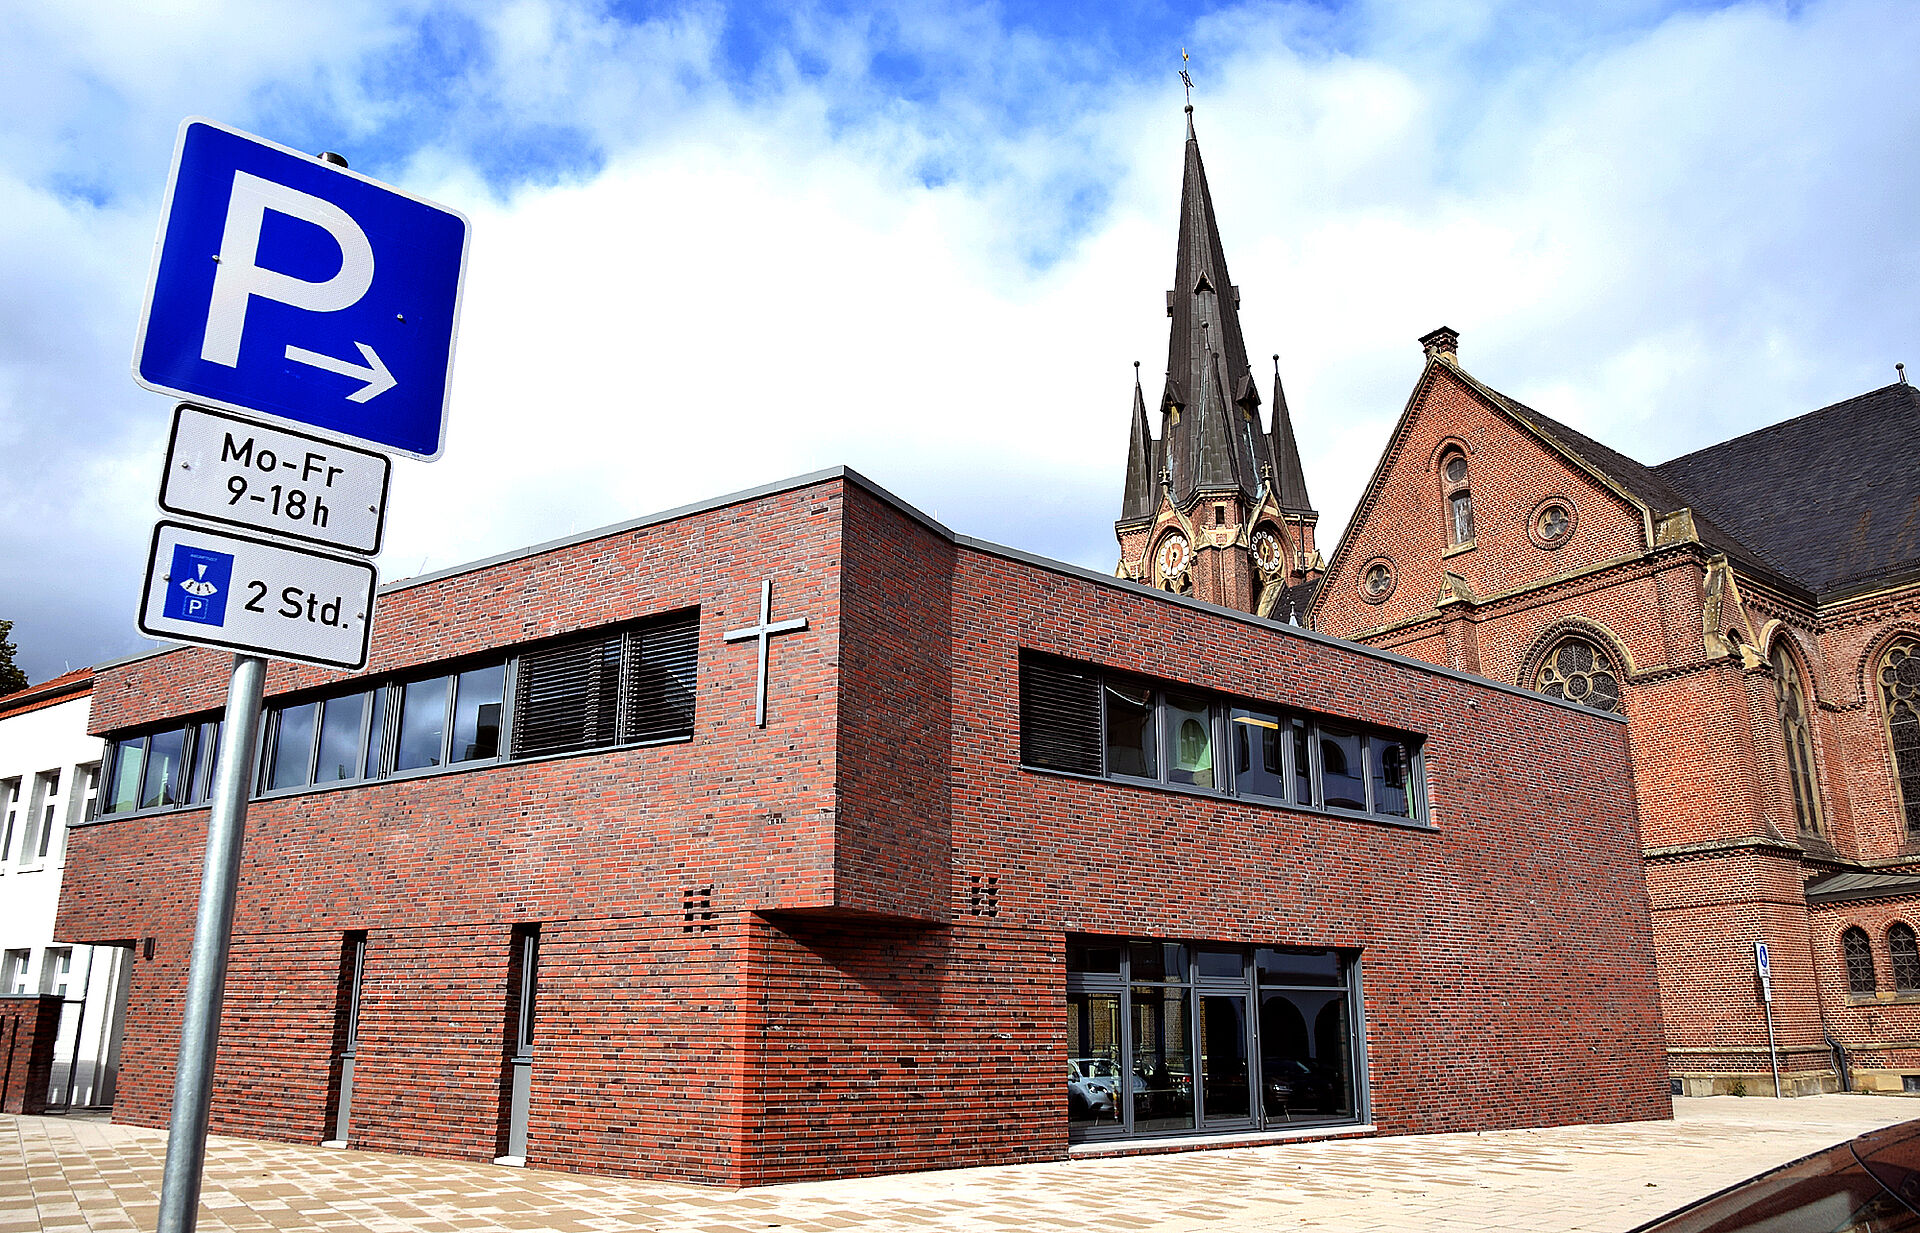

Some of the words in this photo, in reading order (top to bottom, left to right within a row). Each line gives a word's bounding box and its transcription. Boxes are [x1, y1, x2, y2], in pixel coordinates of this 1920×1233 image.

[201, 169, 375, 369] P
[220, 432, 345, 488] Mo-Fr
[227, 475, 330, 528] 9-18h
[189, 599, 202, 615] P
[244, 580, 268, 614] 2
[277, 586, 349, 629] Std.
